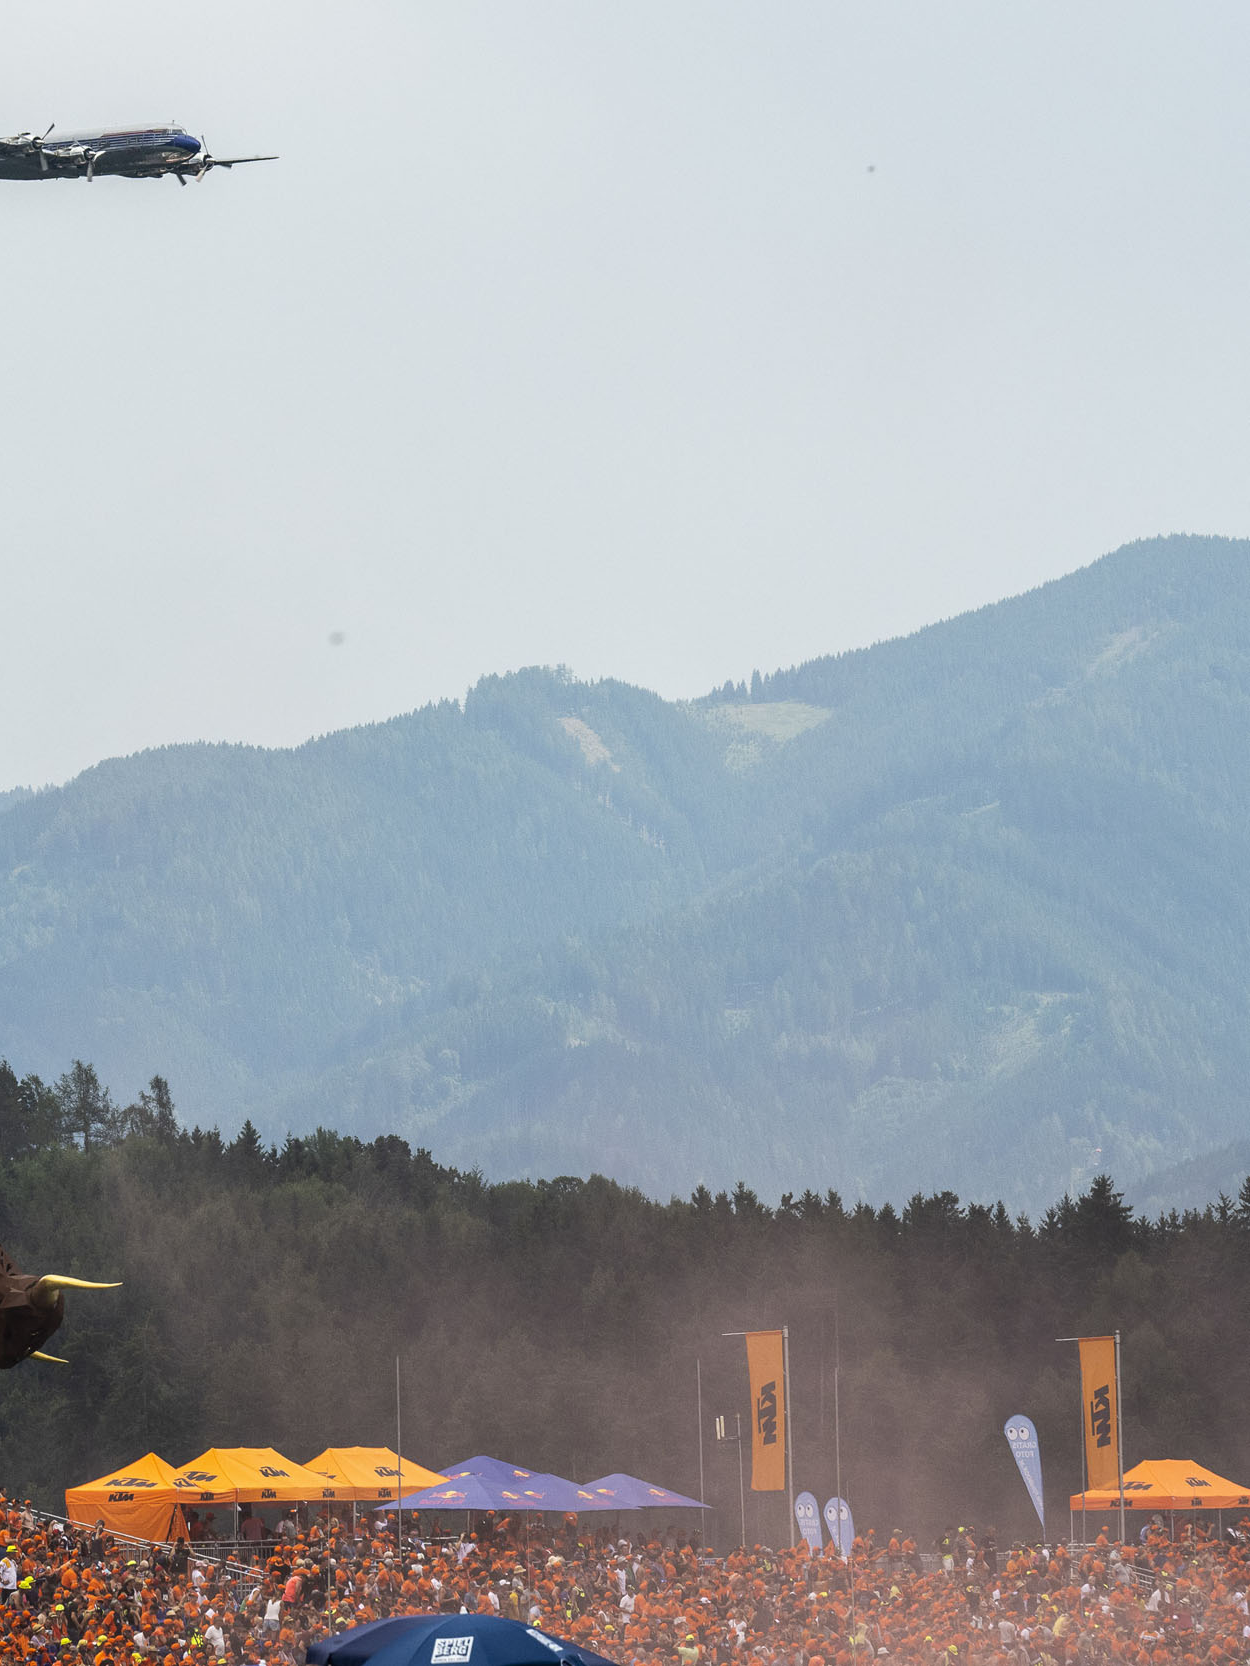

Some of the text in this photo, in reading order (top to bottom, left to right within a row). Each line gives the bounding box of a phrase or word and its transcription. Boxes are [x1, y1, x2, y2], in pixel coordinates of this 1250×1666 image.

[758, 1381, 777, 1446] KTM
[1091, 1384, 1111, 1448] KTM
[259, 1466, 290, 1477] KTM
[374, 1466, 405, 1477] KTM
[103, 1477, 158, 1488] KTM
[1185, 1477, 1212, 1487] KTM
[108, 1491, 134, 1502] KTM
[261, 1488, 276, 1499] KTM
[322, 1488, 335, 1498] KTM
[378, 1487, 391, 1498] KTM
